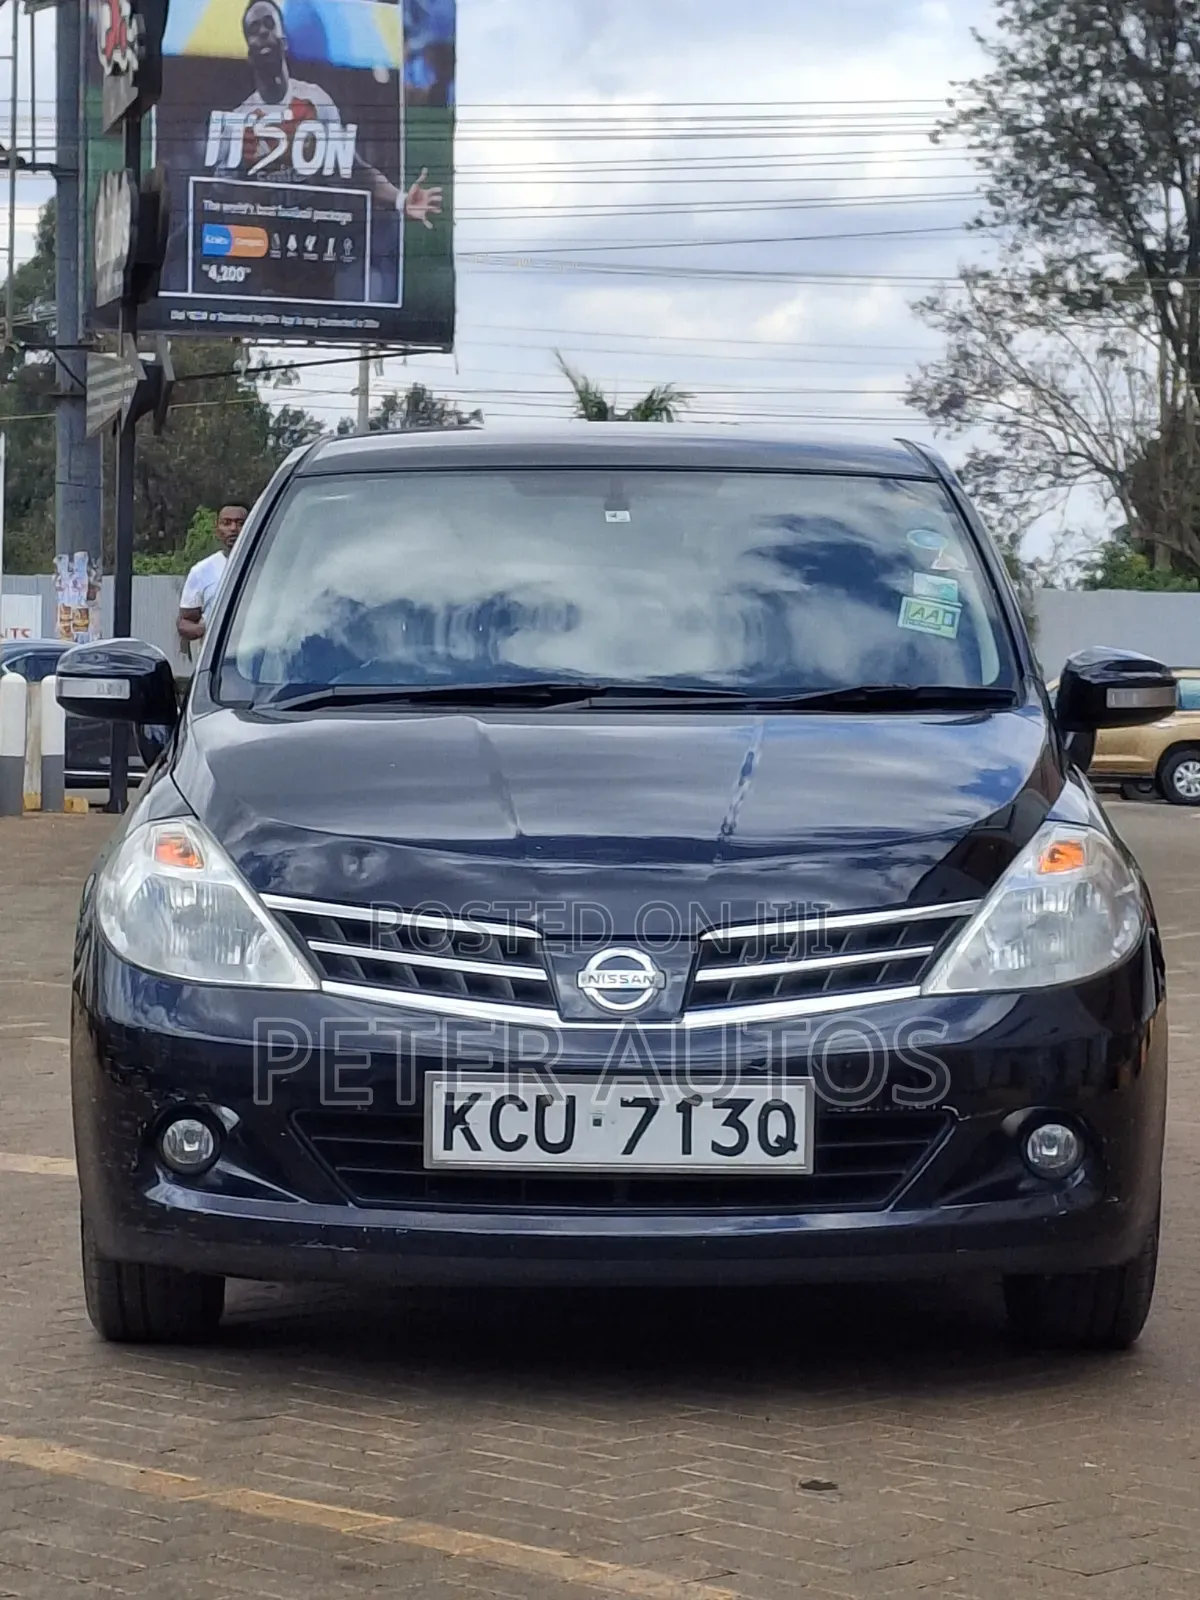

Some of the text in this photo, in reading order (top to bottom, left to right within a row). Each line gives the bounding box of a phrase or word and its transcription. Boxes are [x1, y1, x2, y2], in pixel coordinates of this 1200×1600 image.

[205, 110, 358, 178] IT'S ON
[587, 974, 656, 984] NISSAN
[443, 1092, 799, 1157] KCU 713Q
